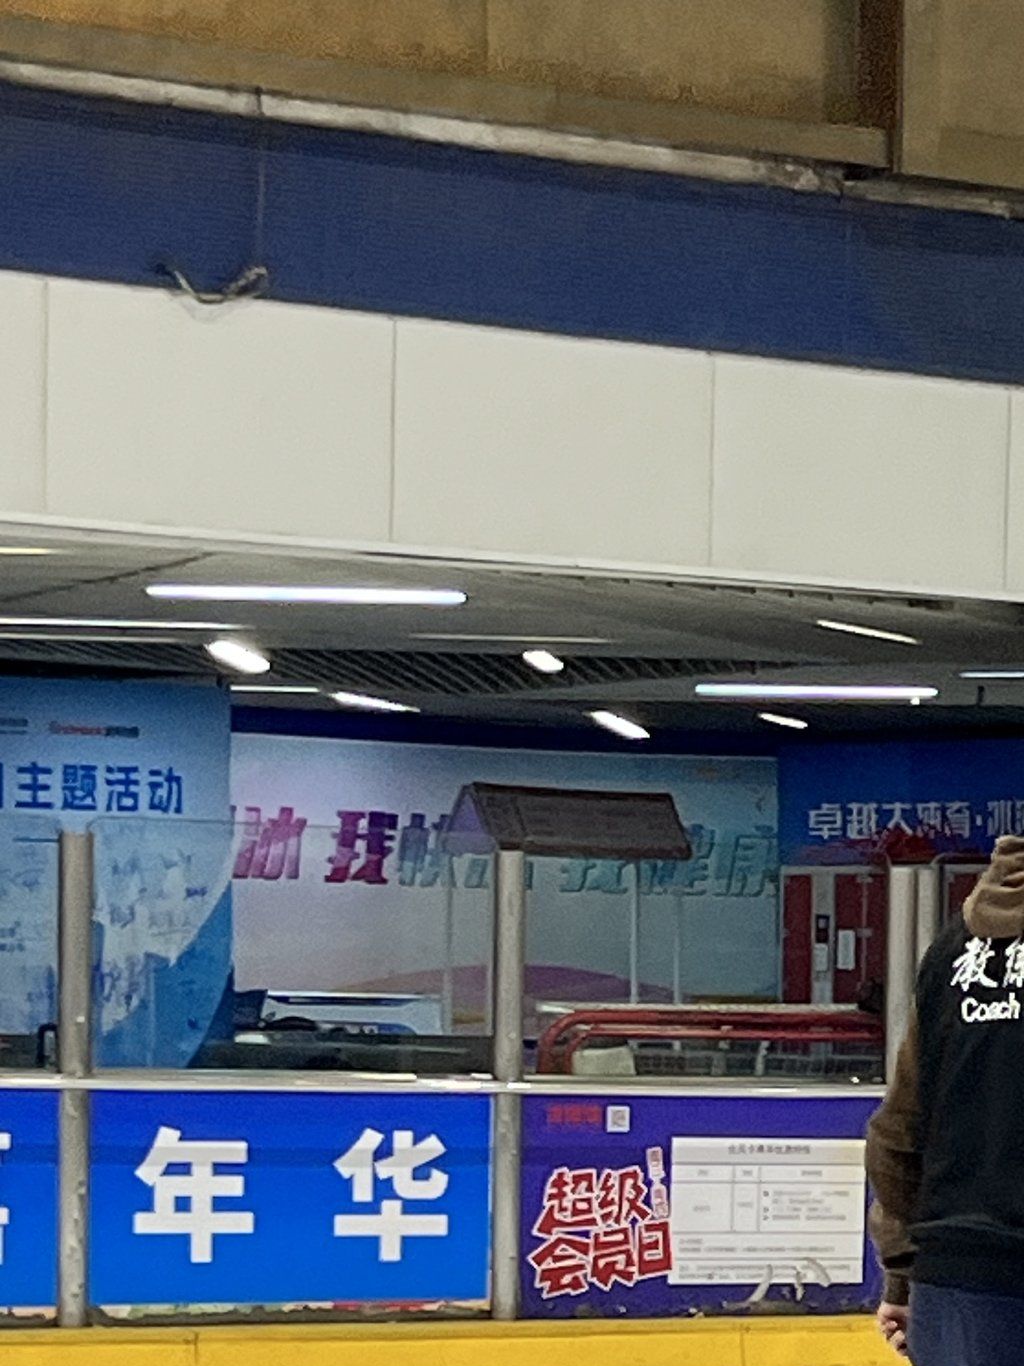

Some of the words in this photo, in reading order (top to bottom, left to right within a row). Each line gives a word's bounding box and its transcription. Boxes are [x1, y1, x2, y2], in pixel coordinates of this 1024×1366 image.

[0, 761, 184, 814] 主题活动
[961, 992, 1021, 1023] Coach
[0, 1126, 449, 1264] 年华
[533, 1167, 651, 1236] 超级
[528, 1218, 672, 1298] 会员日
